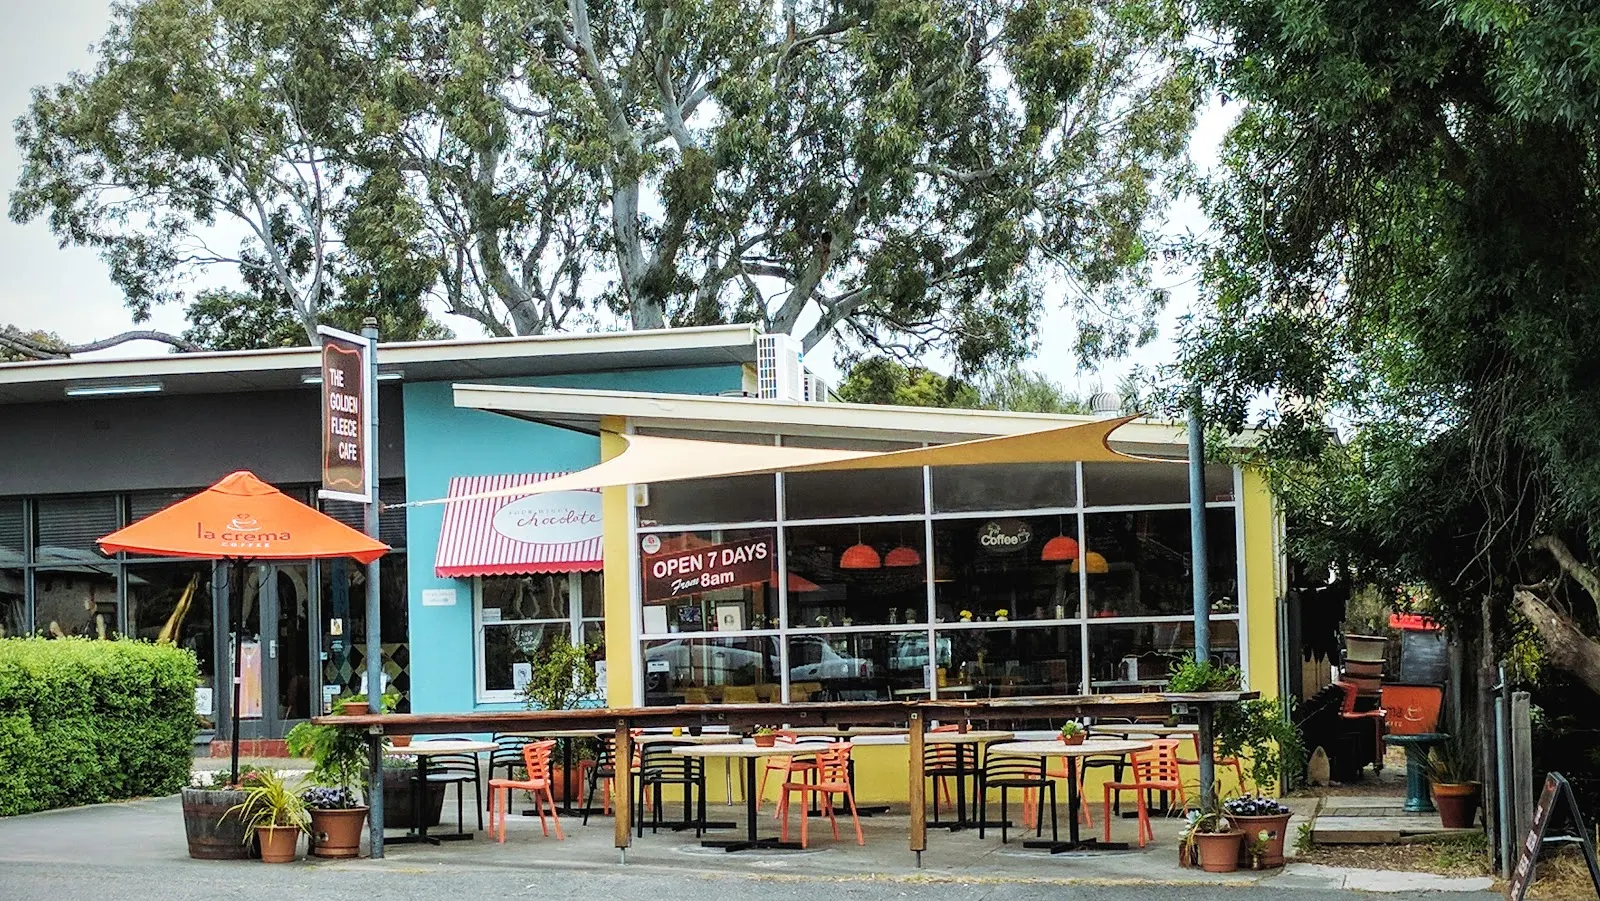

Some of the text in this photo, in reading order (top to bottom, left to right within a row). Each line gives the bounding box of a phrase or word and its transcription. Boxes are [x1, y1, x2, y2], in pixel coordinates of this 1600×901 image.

[329, 368, 345, 388] THE
[329, 392, 358, 414] GOLDEN
[331, 416, 358, 438] FLEECE
[338, 441, 358, 461] CAFE
[517, 509, 603, 527] chocolate
[197, 521, 291, 541] la crema
[981, 533, 1019, 546] Coffee
[652, 542, 768, 578] OPEN 7 DAYS
[670, 571, 735, 596] From 8am
